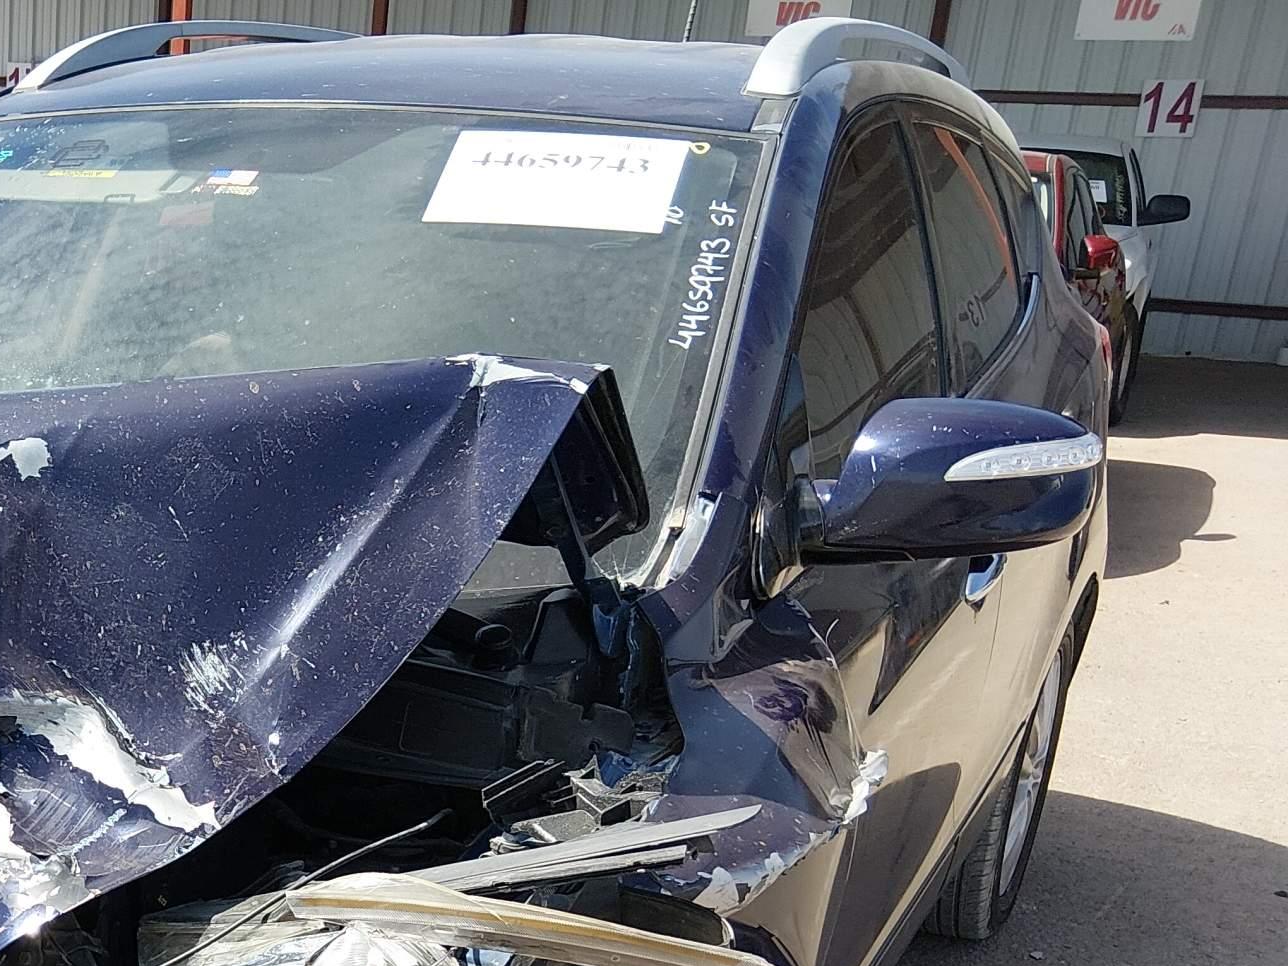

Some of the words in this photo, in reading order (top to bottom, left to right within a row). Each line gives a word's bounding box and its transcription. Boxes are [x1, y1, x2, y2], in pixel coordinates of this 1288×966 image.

[1143, 81, 1195, 134] 14
[471, 151, 650, 174] 44659743
[668, 237, 731, 350] 44659743
[708, 199, 738, 227] SF
